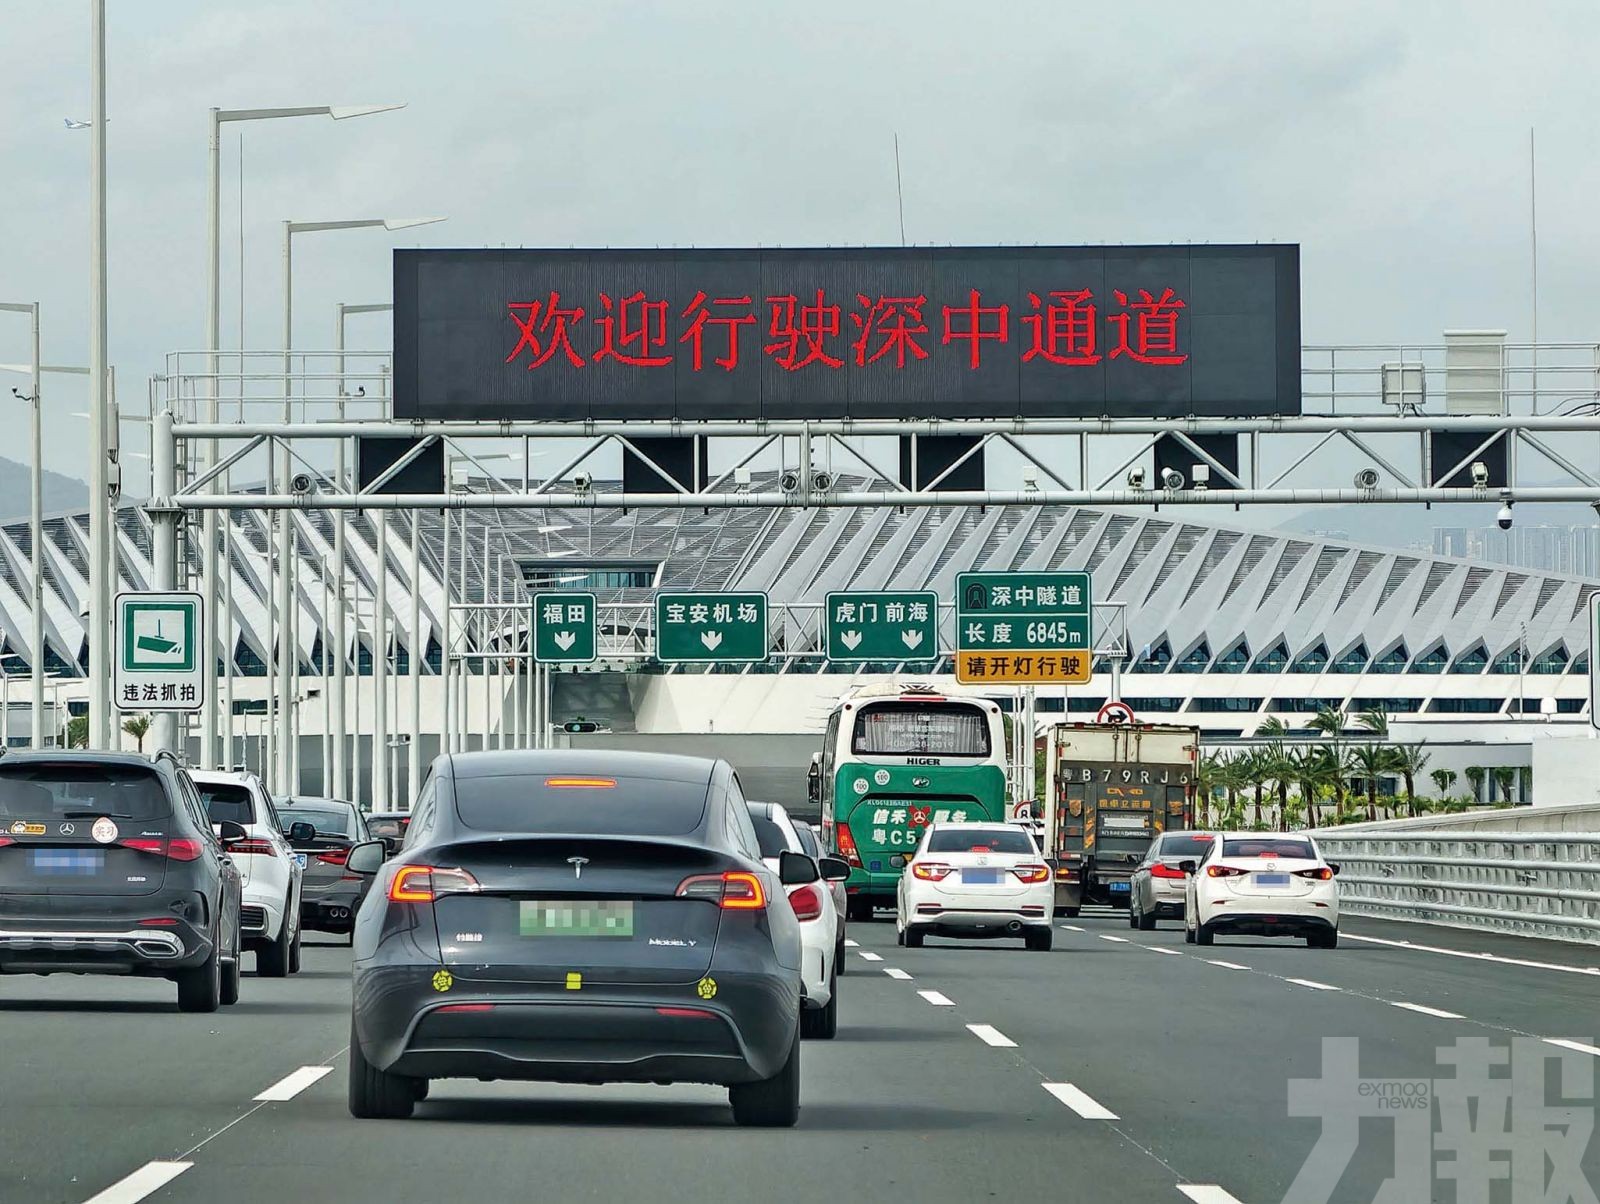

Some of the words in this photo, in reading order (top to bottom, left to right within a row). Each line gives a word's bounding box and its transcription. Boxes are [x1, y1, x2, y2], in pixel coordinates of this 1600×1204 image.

[506, 288, 1189, 371] 欢迎行驶深中通道
[991, 586, 1082, 607] 深中隧道
[543, 604, 585, 624] 福田
[666, 603, 758, 623] 宝安机场
[965, 623, 1012, 643] 长度
[1026, 622, 1081, 643] 6845m
[967, 656, 1080, 676] 请开灯行驶
[123, 683, 196, 701] 违法抓拍
[873, 809, 906, 824] 信禾
